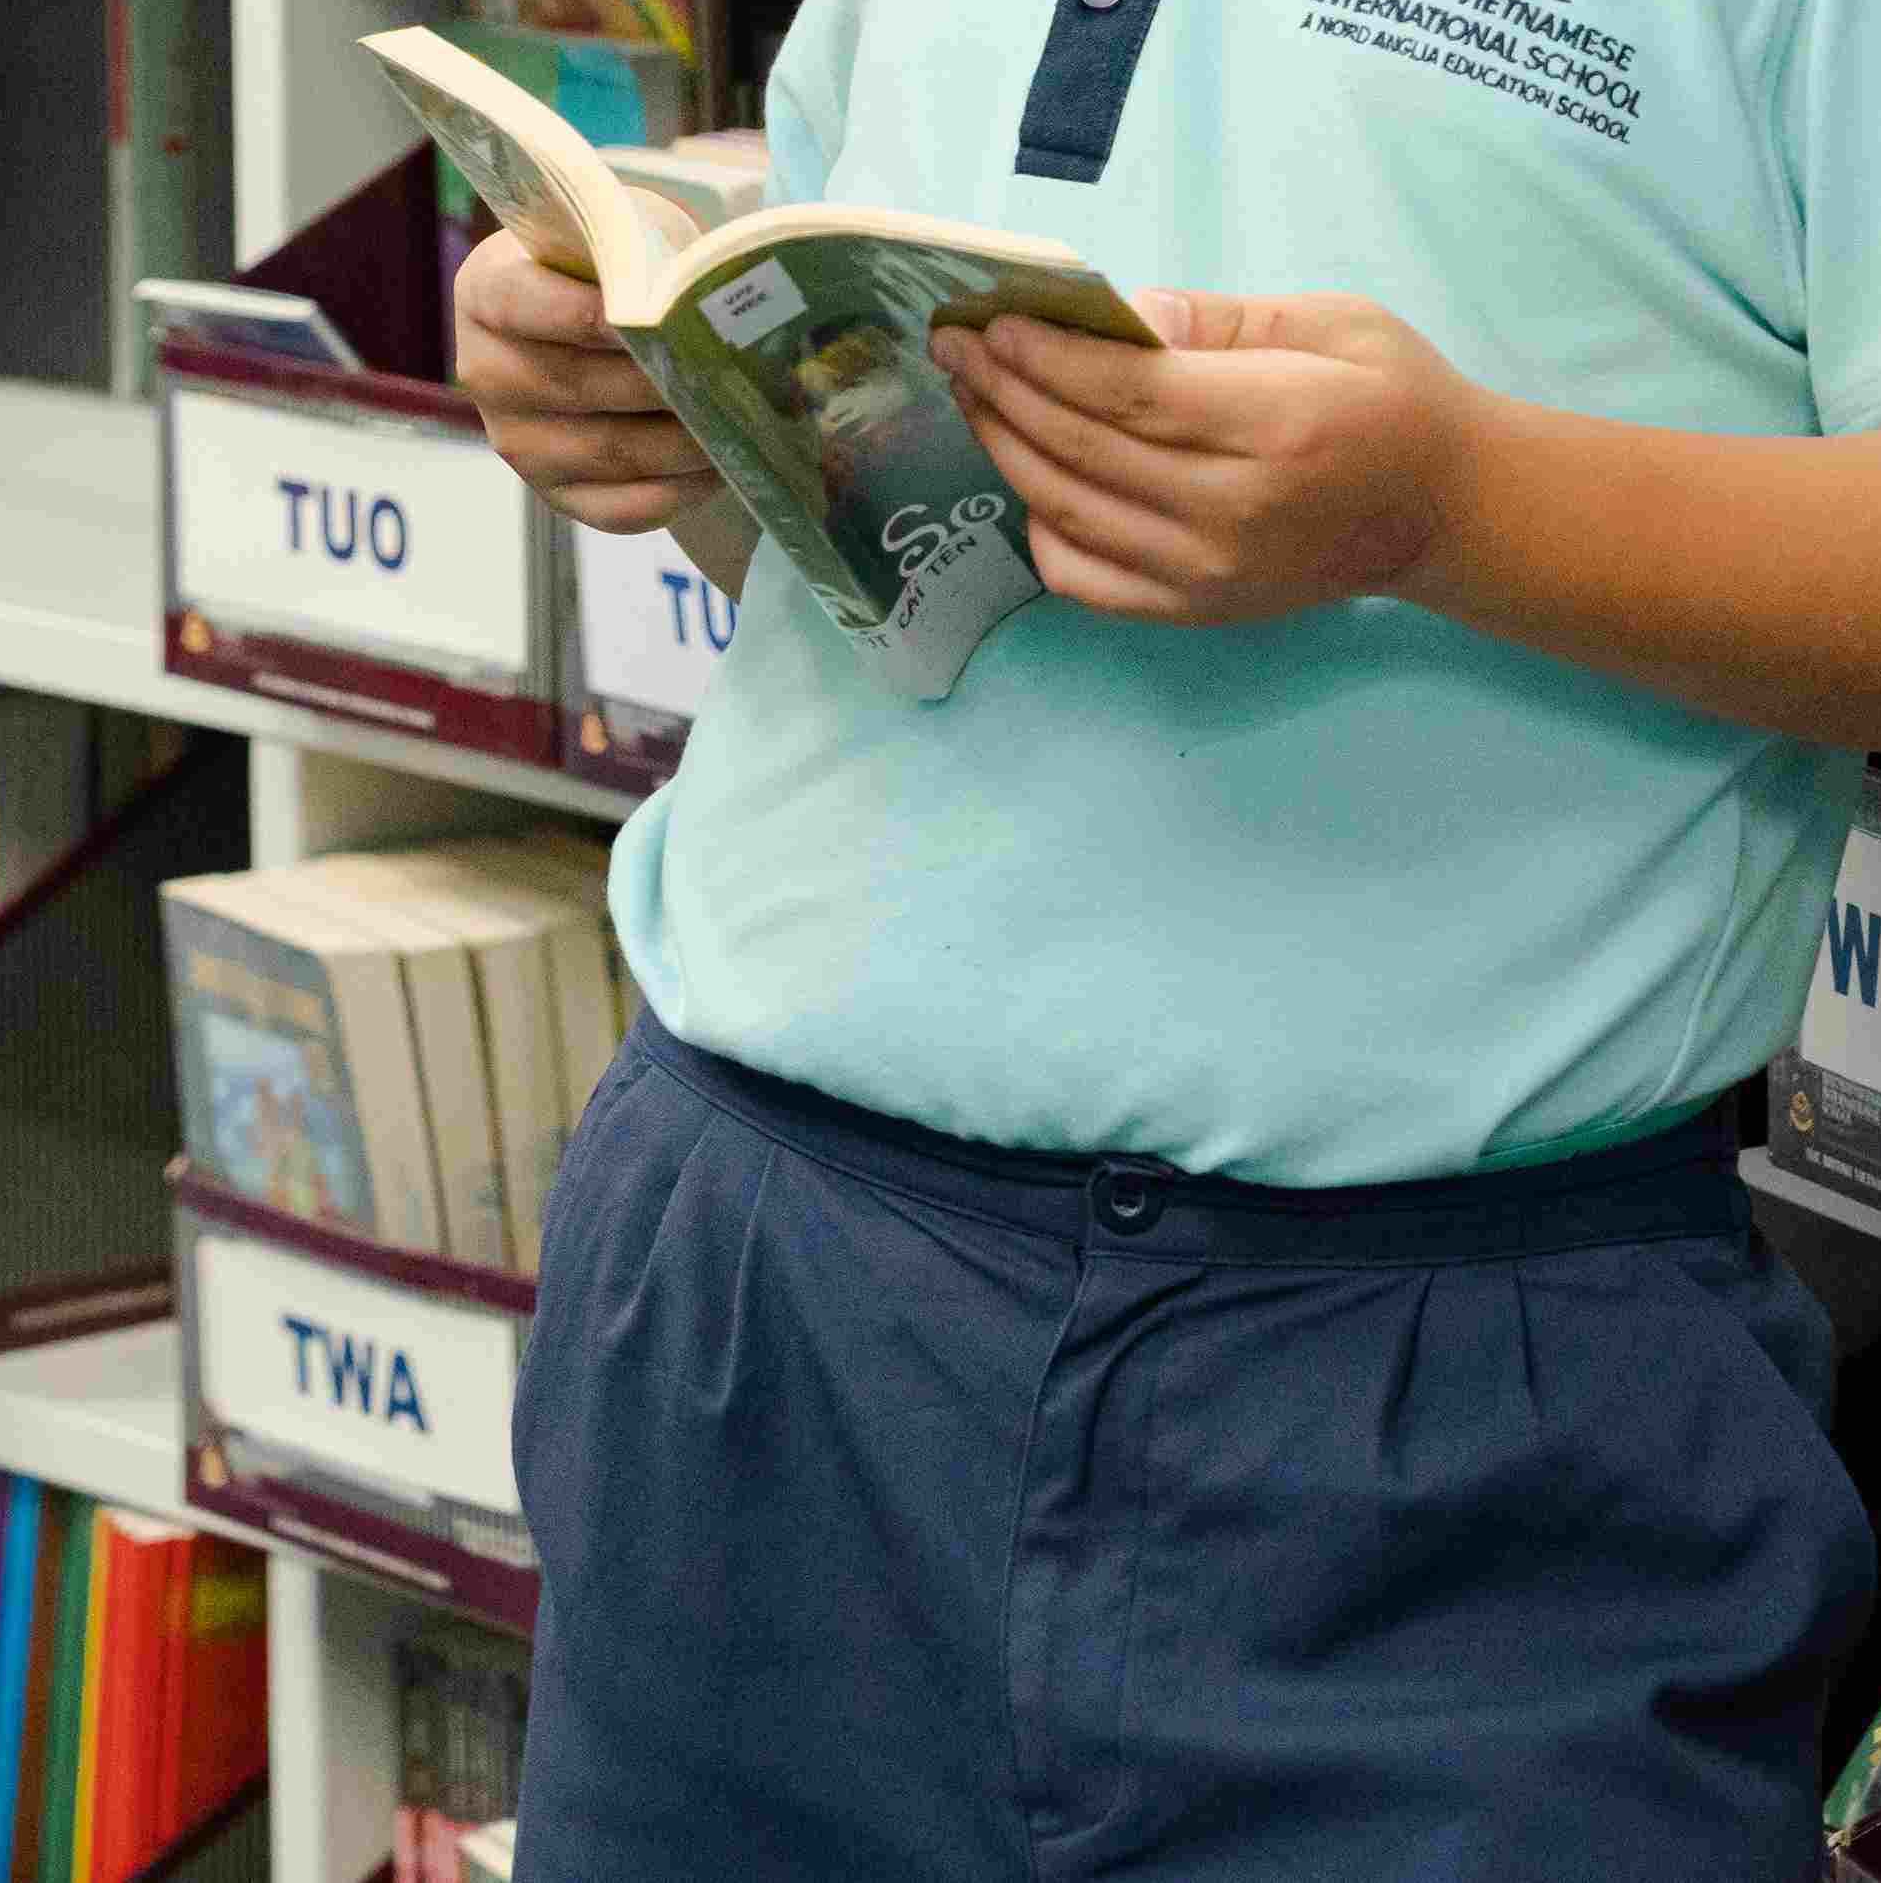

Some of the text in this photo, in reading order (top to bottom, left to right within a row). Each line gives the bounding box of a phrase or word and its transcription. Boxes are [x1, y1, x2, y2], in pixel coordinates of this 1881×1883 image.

[1299, 14, 1631, 144] A NORD ANGLIA EDUCATION SCHOOL
[1523, 45, 1642, 119] SCHOOL
[278, 479, 407, 572] TUO
[282, 1317, 431, 1433] TWA
